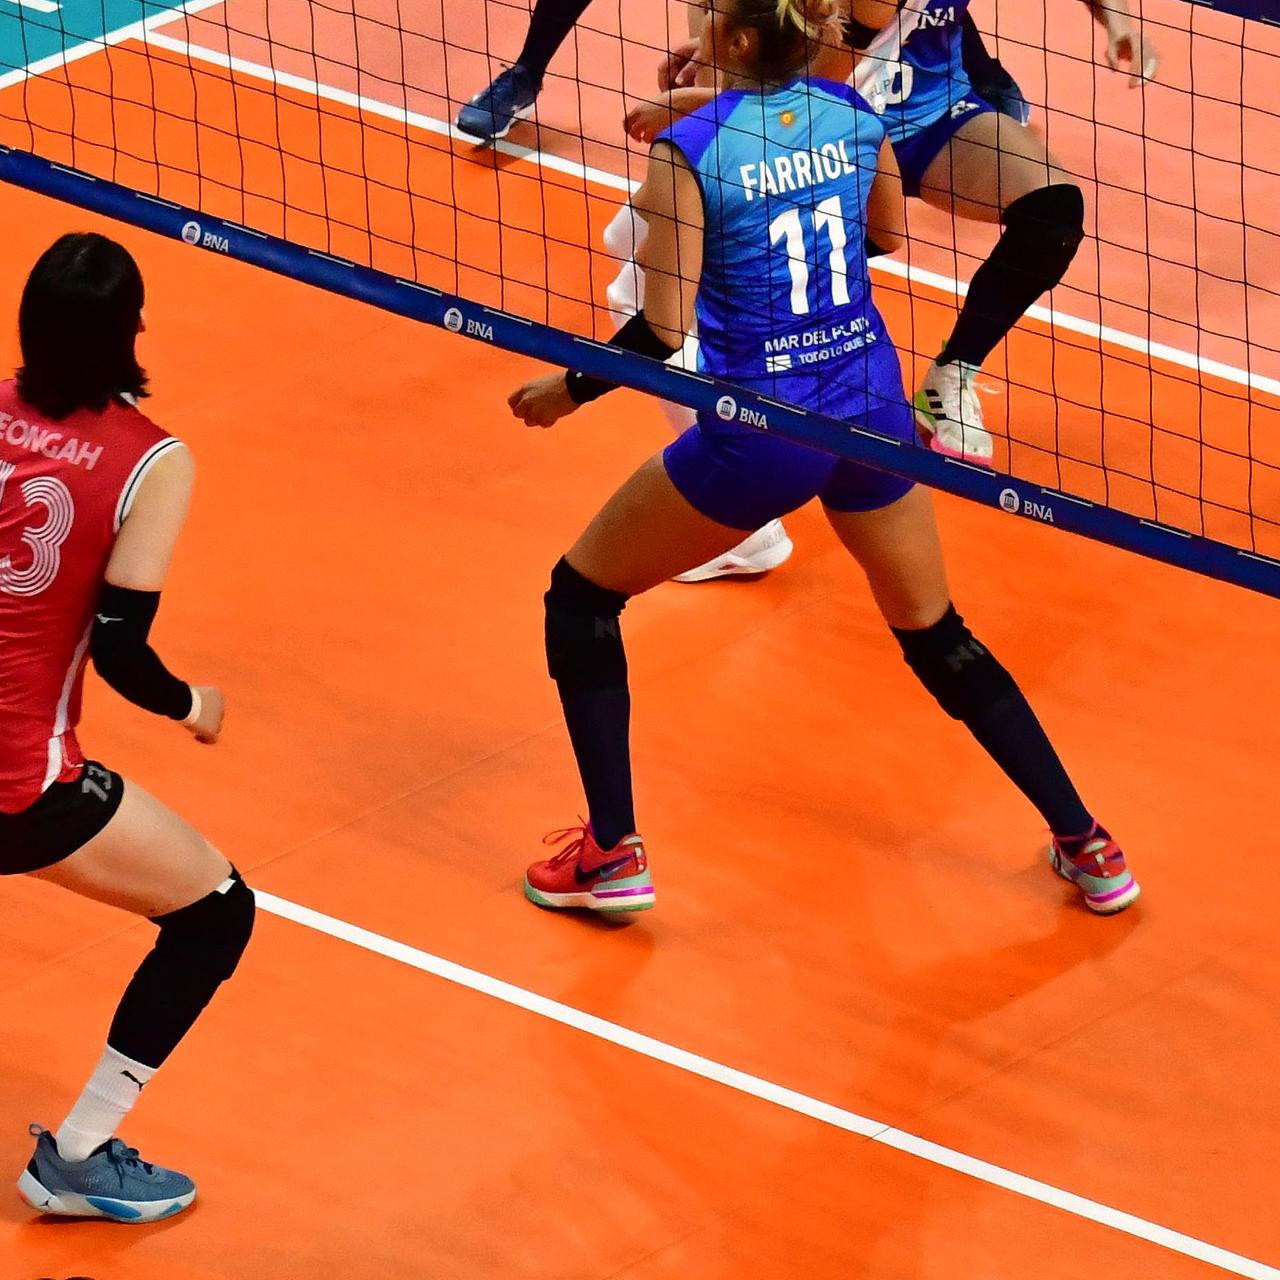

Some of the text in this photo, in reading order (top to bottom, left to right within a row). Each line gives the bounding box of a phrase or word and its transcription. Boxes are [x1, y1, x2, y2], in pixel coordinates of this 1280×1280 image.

[918, 6, 955, 30] NA
[739, 139, 856, 201] FARRIOL
[203, 232, 228, 252] BNA
[769, 195, 851, 315] 11
[467, 320, 493, 340] BNA
[765, 334, 799, 352] MAR
[802, 330, 830, 347] DEL
[843, 336, 865, 352] QUE
[739, 408, 767, 429] BNA
[1024, 501, 1053, 522] BNA
